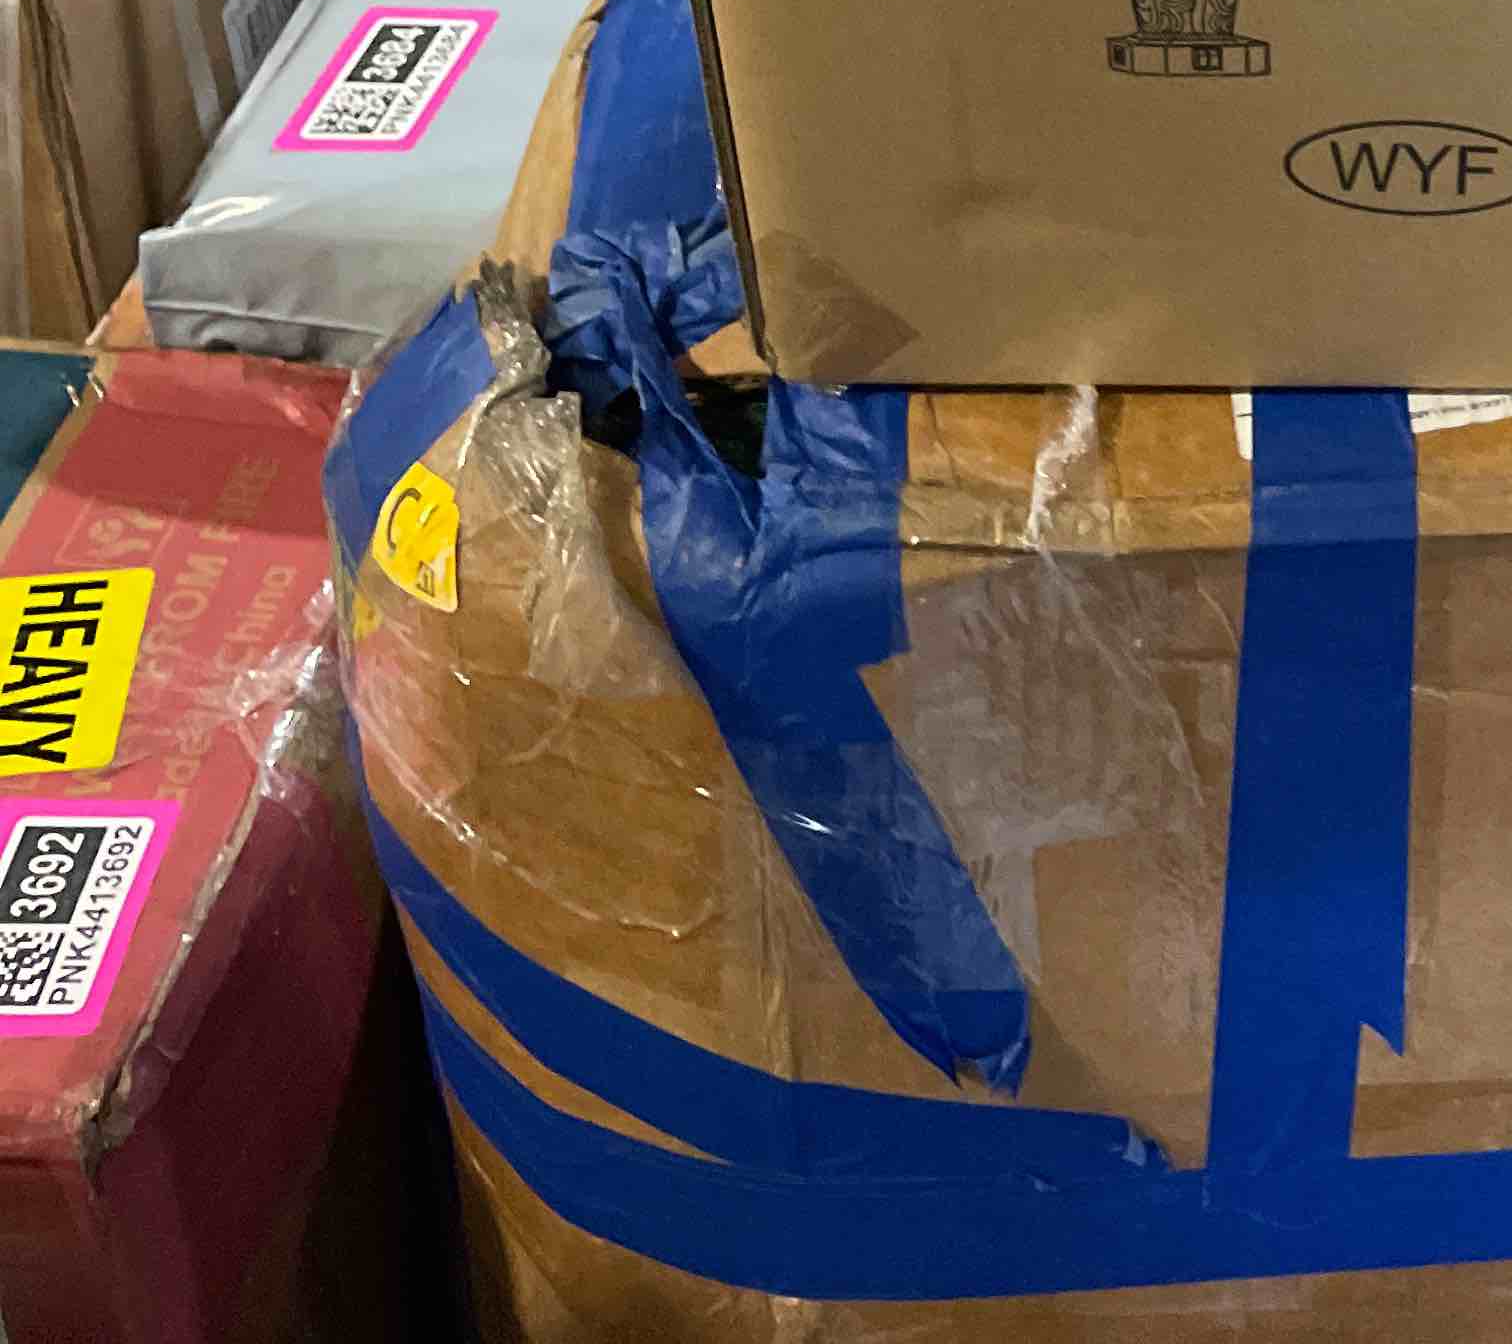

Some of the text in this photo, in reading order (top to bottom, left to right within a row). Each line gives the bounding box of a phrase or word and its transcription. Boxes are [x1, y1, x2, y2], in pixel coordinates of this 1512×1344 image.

[1329, 139, 1501, 196] WYF
[0, 578, 110, 765] HEAVY
[9, 831, 86, 920] 3692
[47, 824, 143, 1005] PNK4413692
